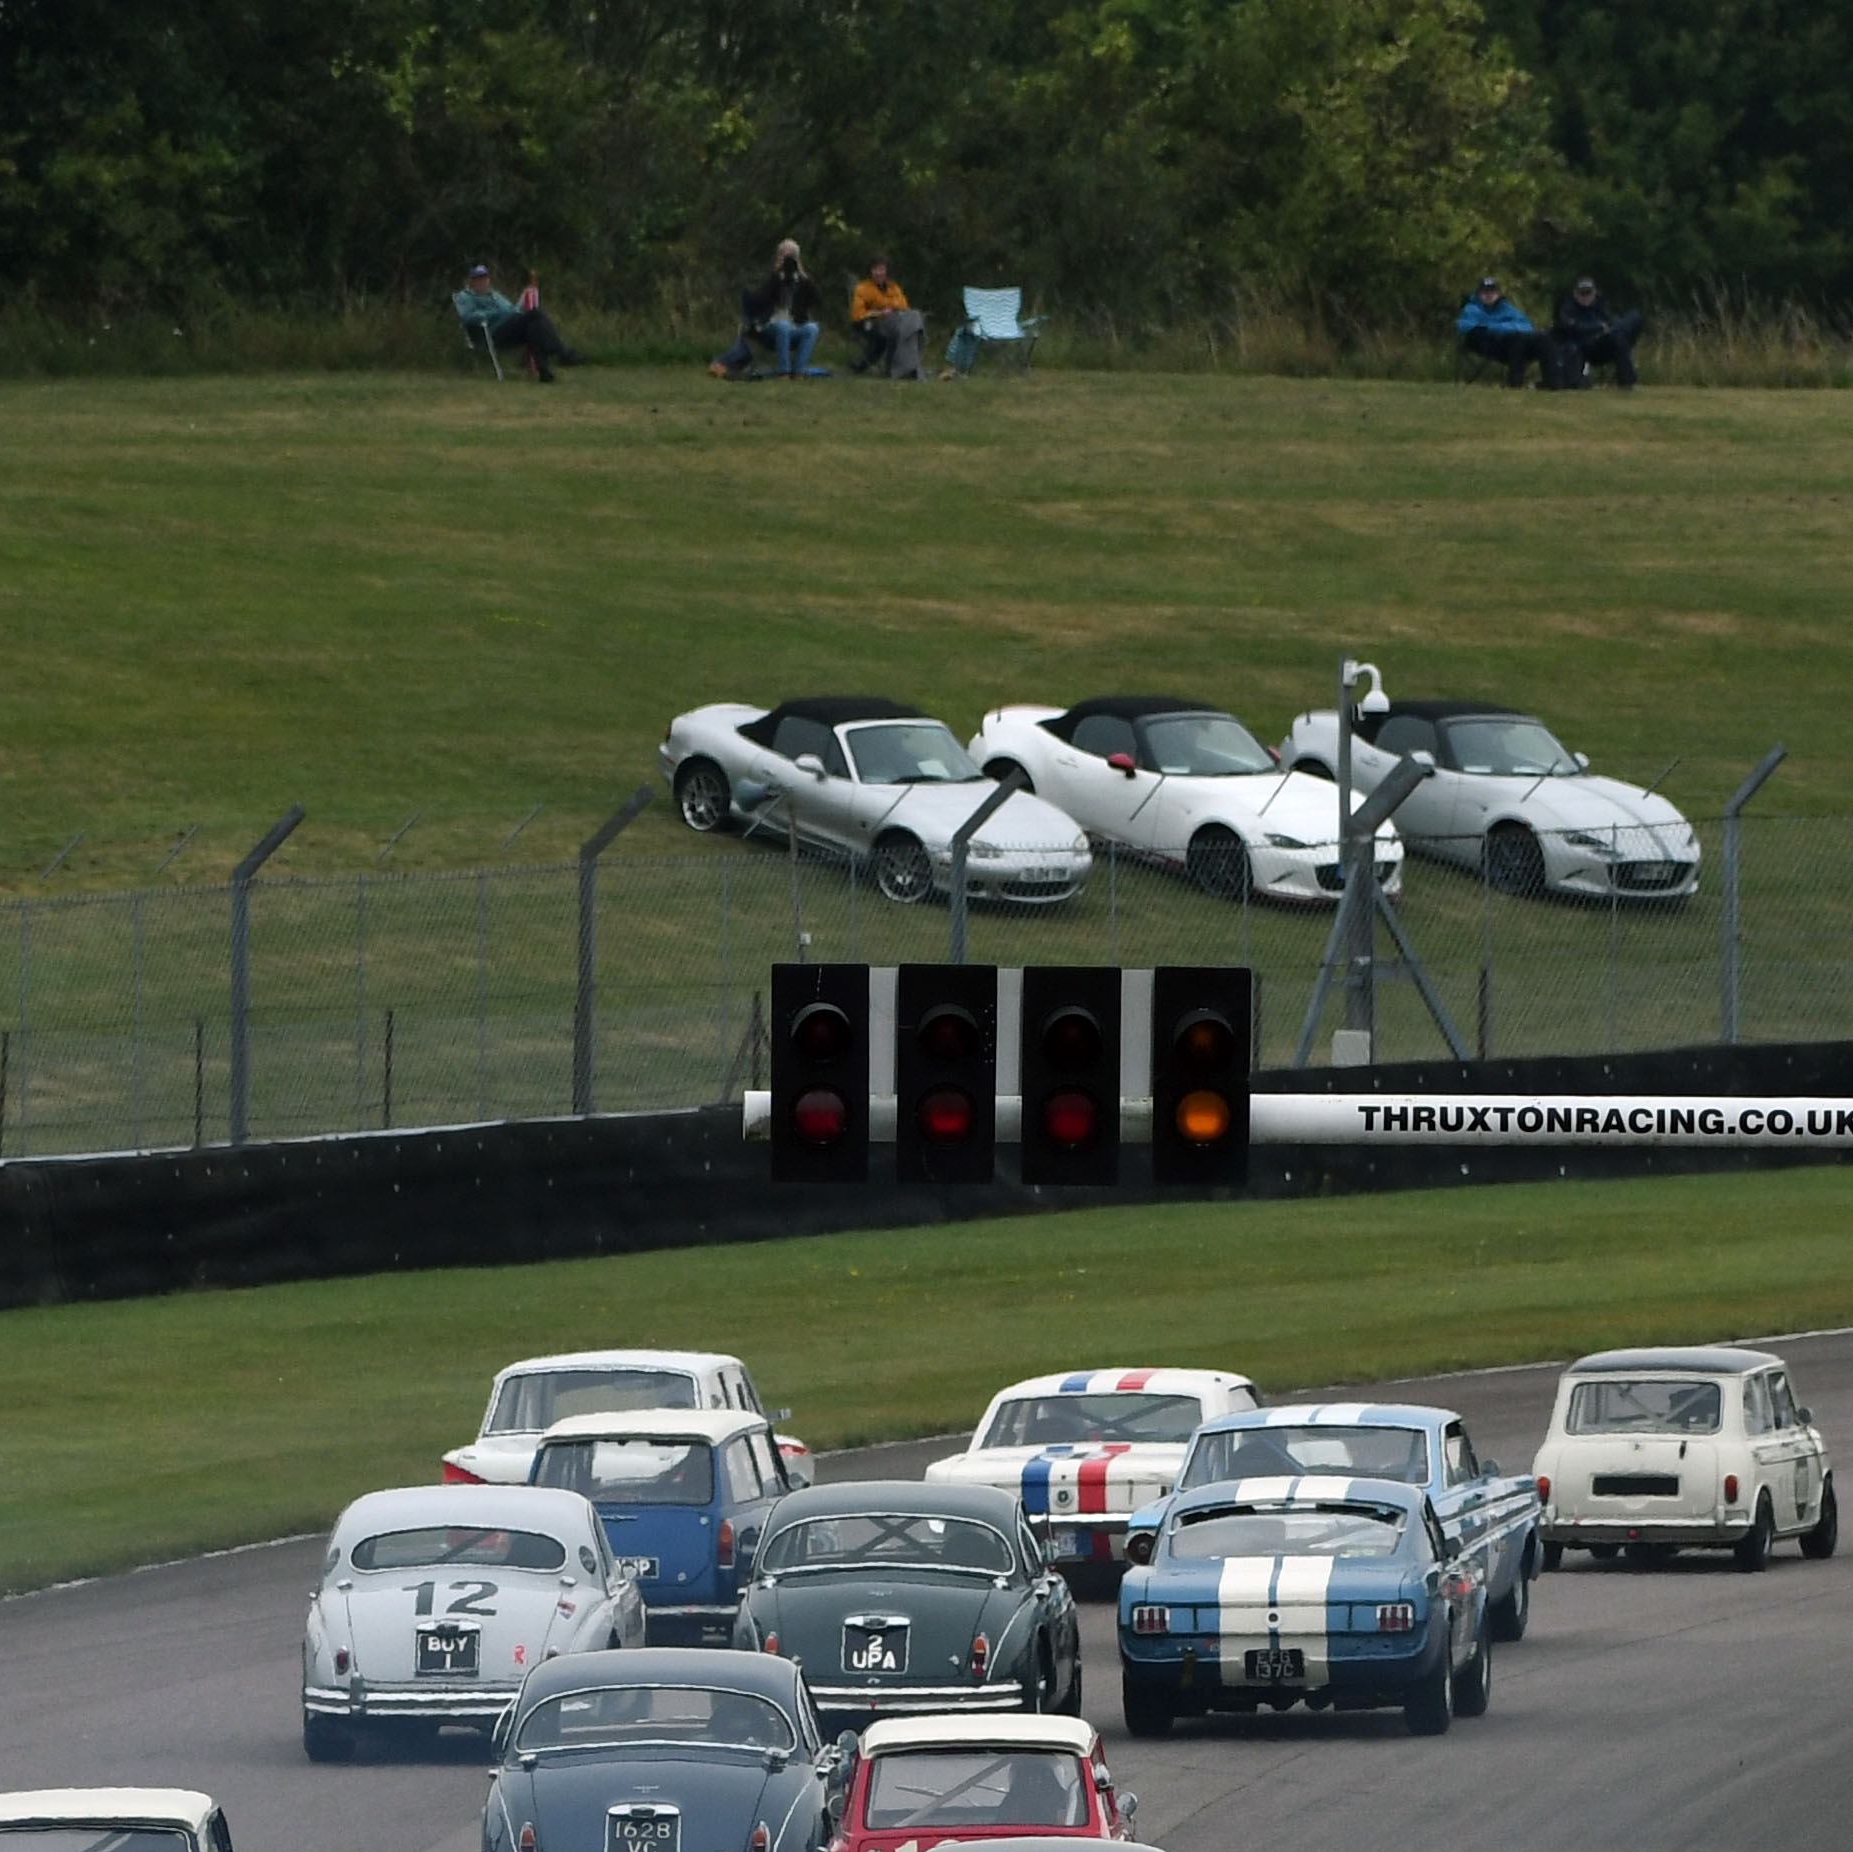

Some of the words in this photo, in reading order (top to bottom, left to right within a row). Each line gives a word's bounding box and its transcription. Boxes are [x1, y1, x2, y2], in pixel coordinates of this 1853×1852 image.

[403, 1581, 499, 1617] 12
[427, 1636, 468, 1652] BUY
[867, 1634, 883, 1652] 2
[852, 1650, 897, 1670] UPA
[615, 1821, 672, 1839] 1628
